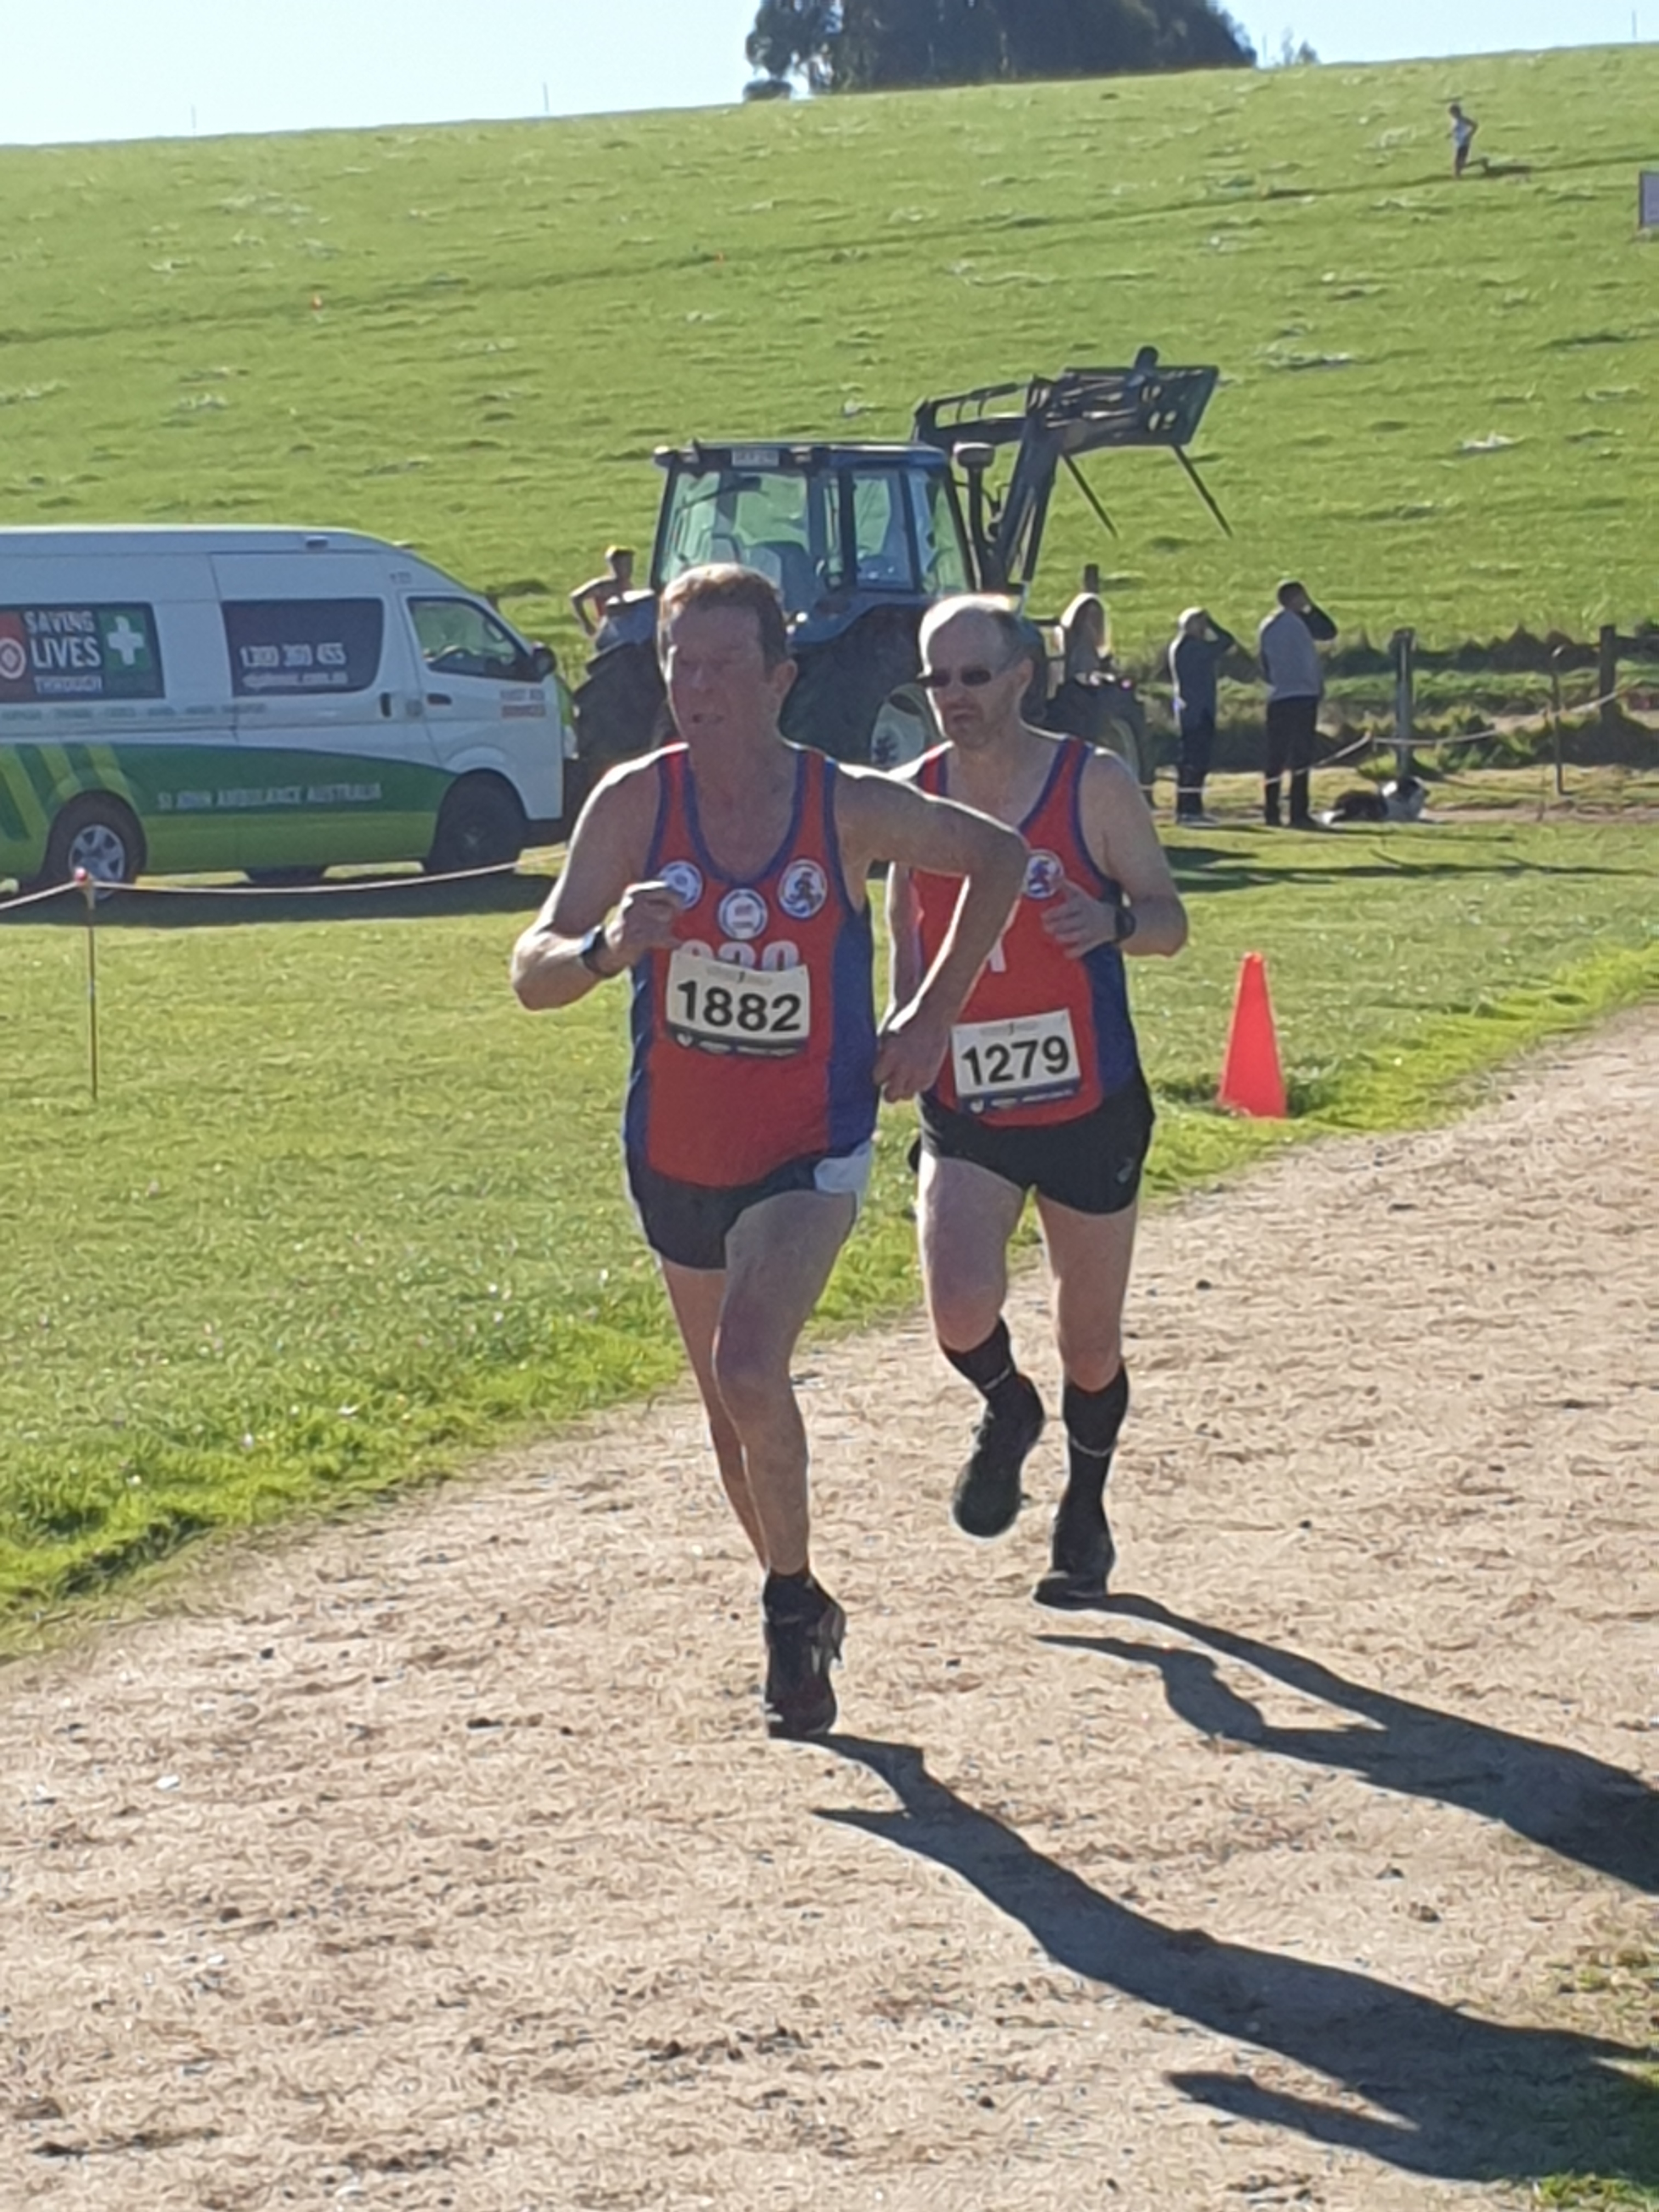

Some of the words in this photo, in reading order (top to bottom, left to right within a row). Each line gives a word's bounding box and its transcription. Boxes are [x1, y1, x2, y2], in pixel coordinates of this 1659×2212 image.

[24, 611, 95, 634] SAVING
[30, 636, 101, 668] LIVES
[677, 980, 802, 1032] 1882
[961, 1035, 1070, 1086] 1279
